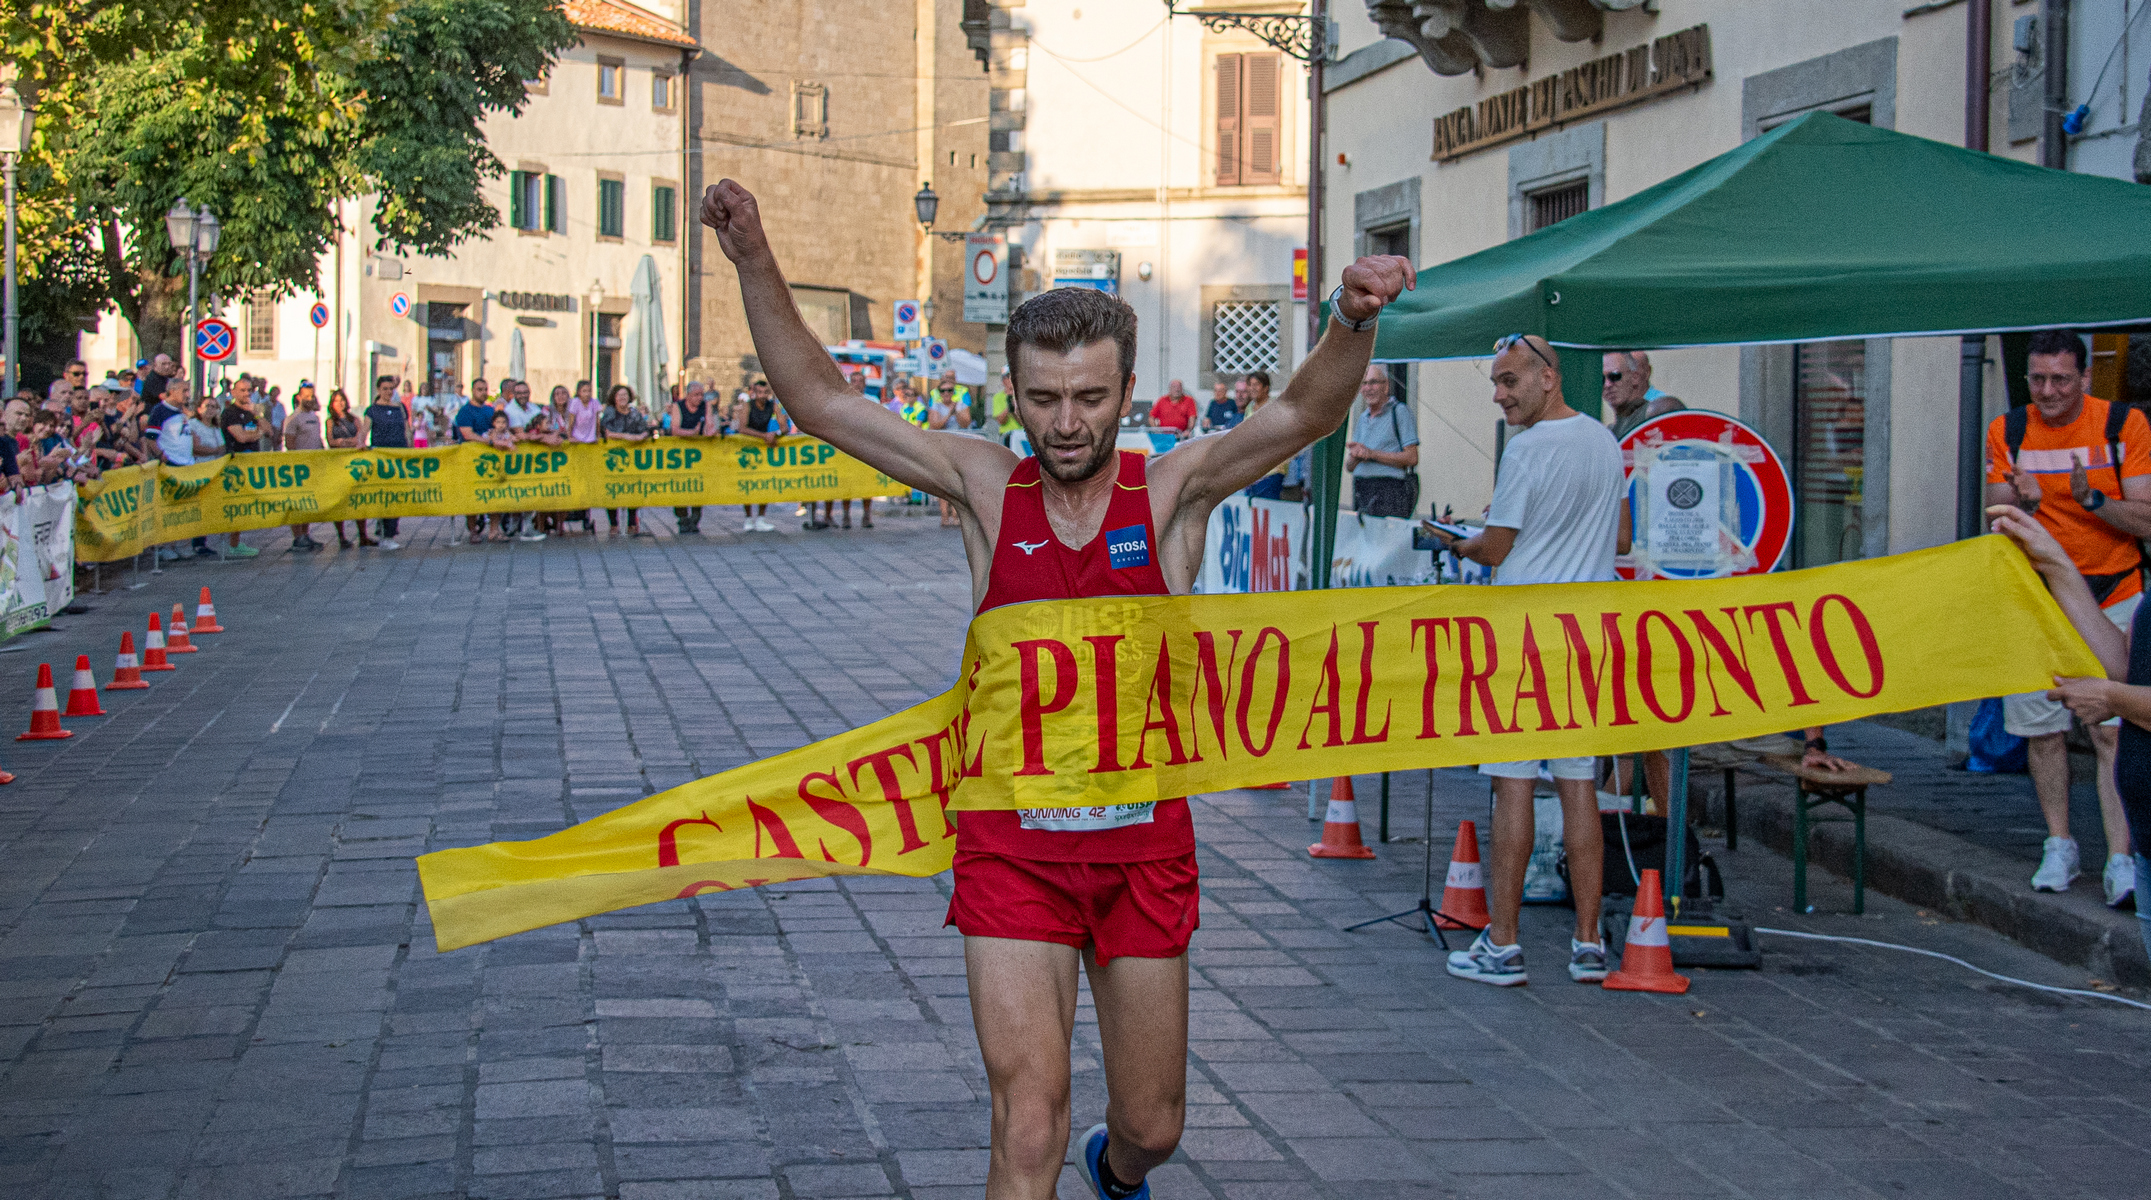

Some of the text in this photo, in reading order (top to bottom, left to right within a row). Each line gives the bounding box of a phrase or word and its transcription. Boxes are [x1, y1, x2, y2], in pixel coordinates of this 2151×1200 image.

[504, 451, 568, 475] UISP
[634, 448, 702, 471] UISP
[767, 444, 836, 467] UISP
[248, 464, 310, 490] UISP
[377, 457, 440, 479] UISP
[474, 477, 571, 503] sportpertutti
[605, 473, 704, 499] sportpertutti
[737, 470, 838, 495] sportpertutti
[222, 492, 319, 522] sportpertutti
[349, 486, 443, 509] sportpertutti
[1109, 540, 1147, 555] STOSA
[1011, 626, 1291, 777] PIANO
[1297, 621, 1391, 750] AL
[1411, 593, 1885, 740] TRAMONTO
[1023, 808, 1081, 819] RUNNING
